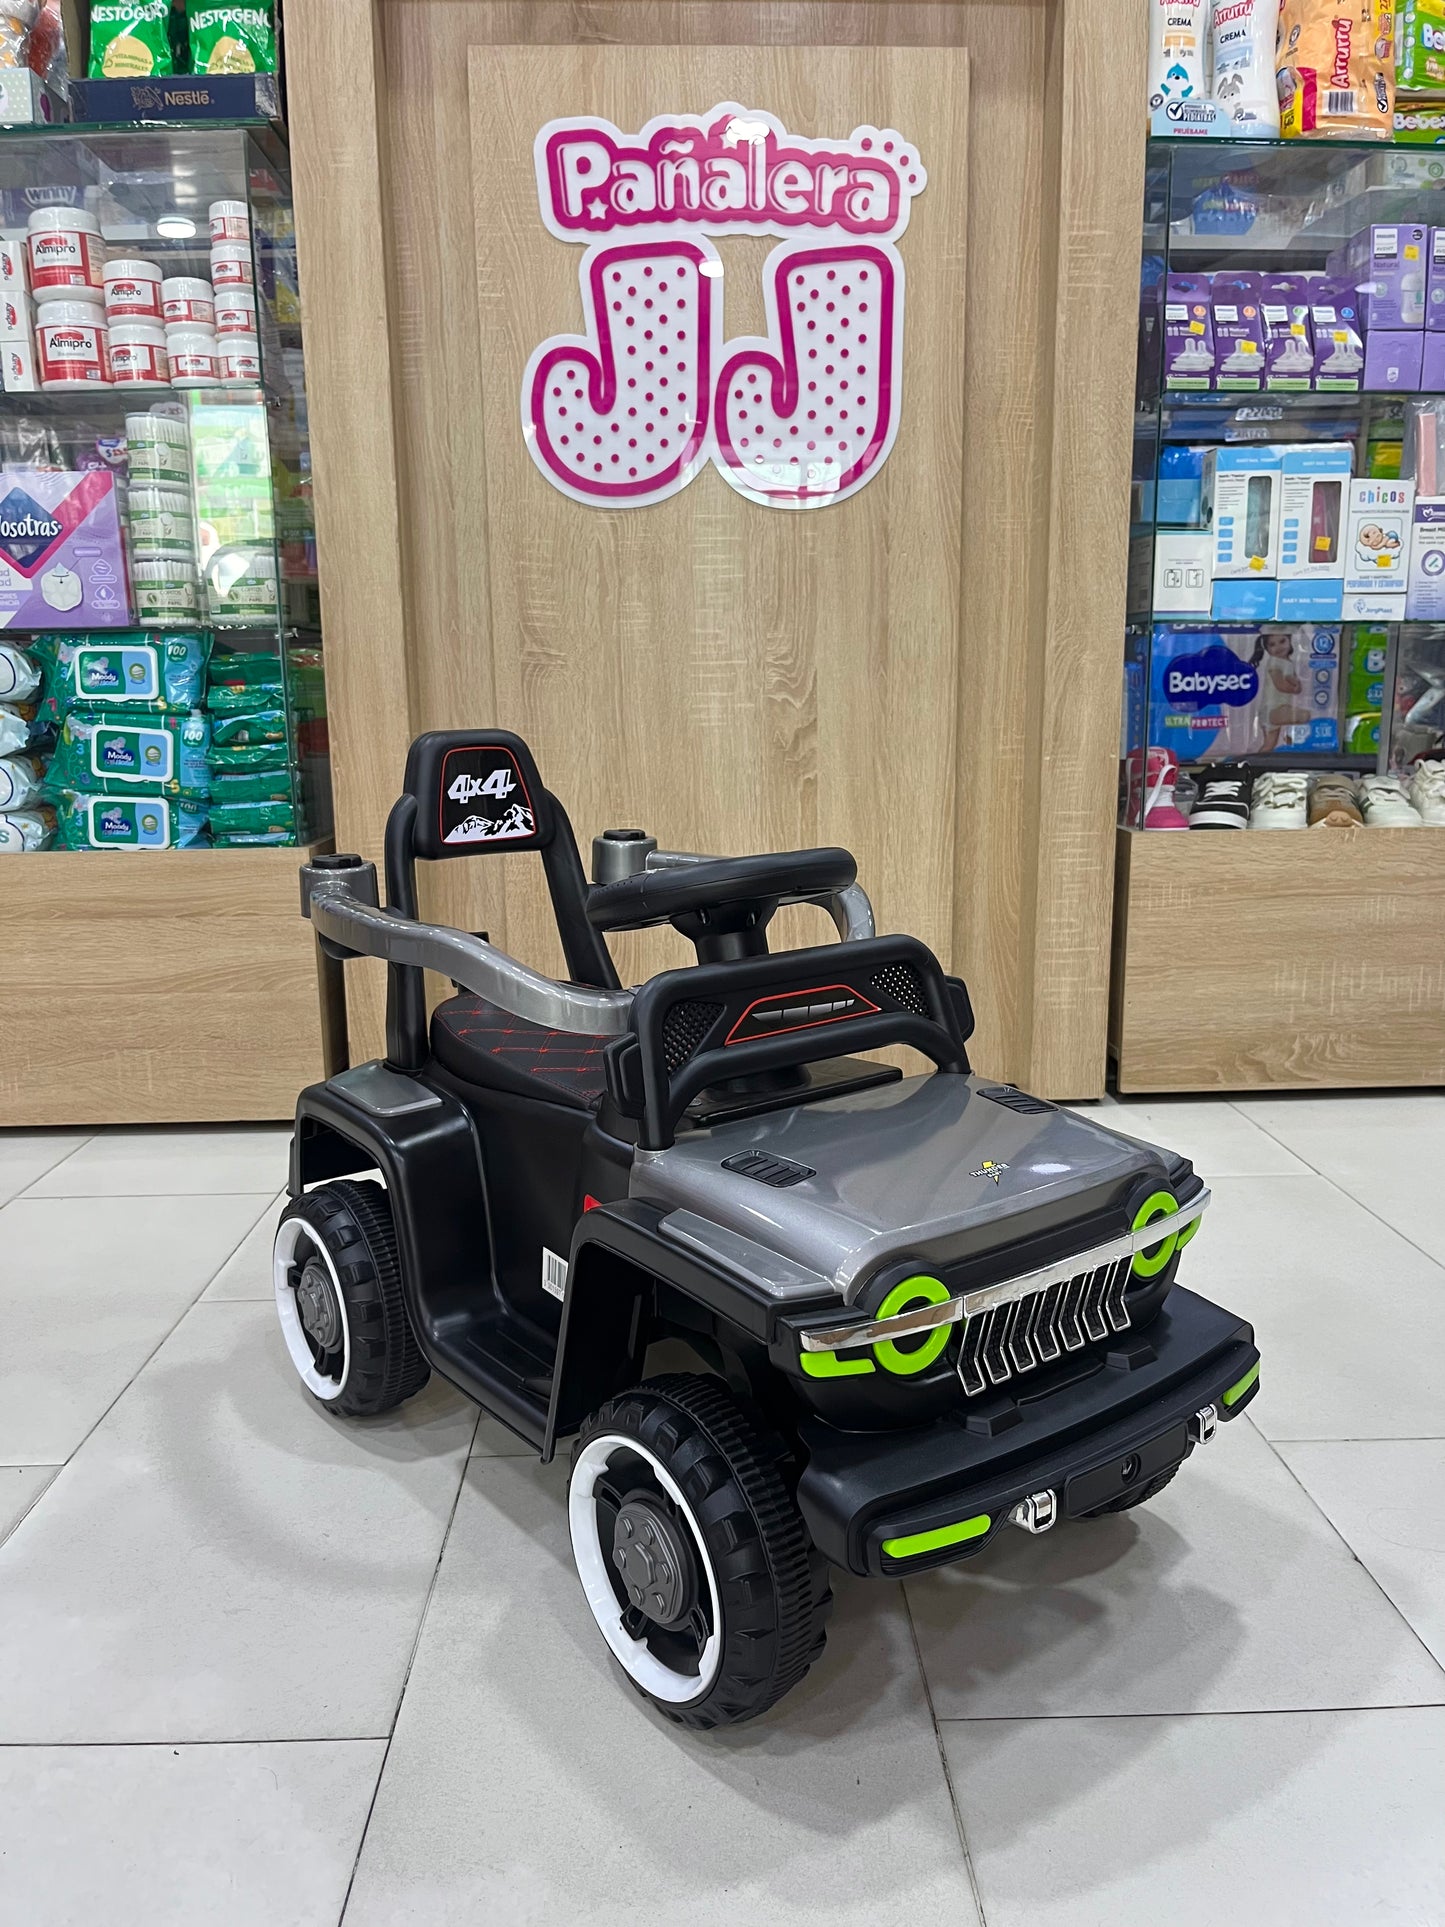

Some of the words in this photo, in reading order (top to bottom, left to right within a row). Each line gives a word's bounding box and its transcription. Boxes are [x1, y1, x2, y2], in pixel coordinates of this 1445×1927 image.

[1167, 17, 1192, 27] CREMA
[1220, 29, 1247, 44] CREMA
[553, 132, 894, 228] Pañalera
[35, 243, 76, 255] Almipro
[49, 337, 92, 351] Almipro
[531, 240, 894, 498] JJ
[1359, 486, 1405, 504] chicos
[0, 512, 59, 538] osotras
[91, 672, 117, 682] Moody
[1169, 671, 1251, 695] Babysec
[183, 729, 203, 741] 100
[107, 750, 132, 762] Moody
[447, 769, 517, 804] 4x4
[105, 820, 130, 832] Moody
